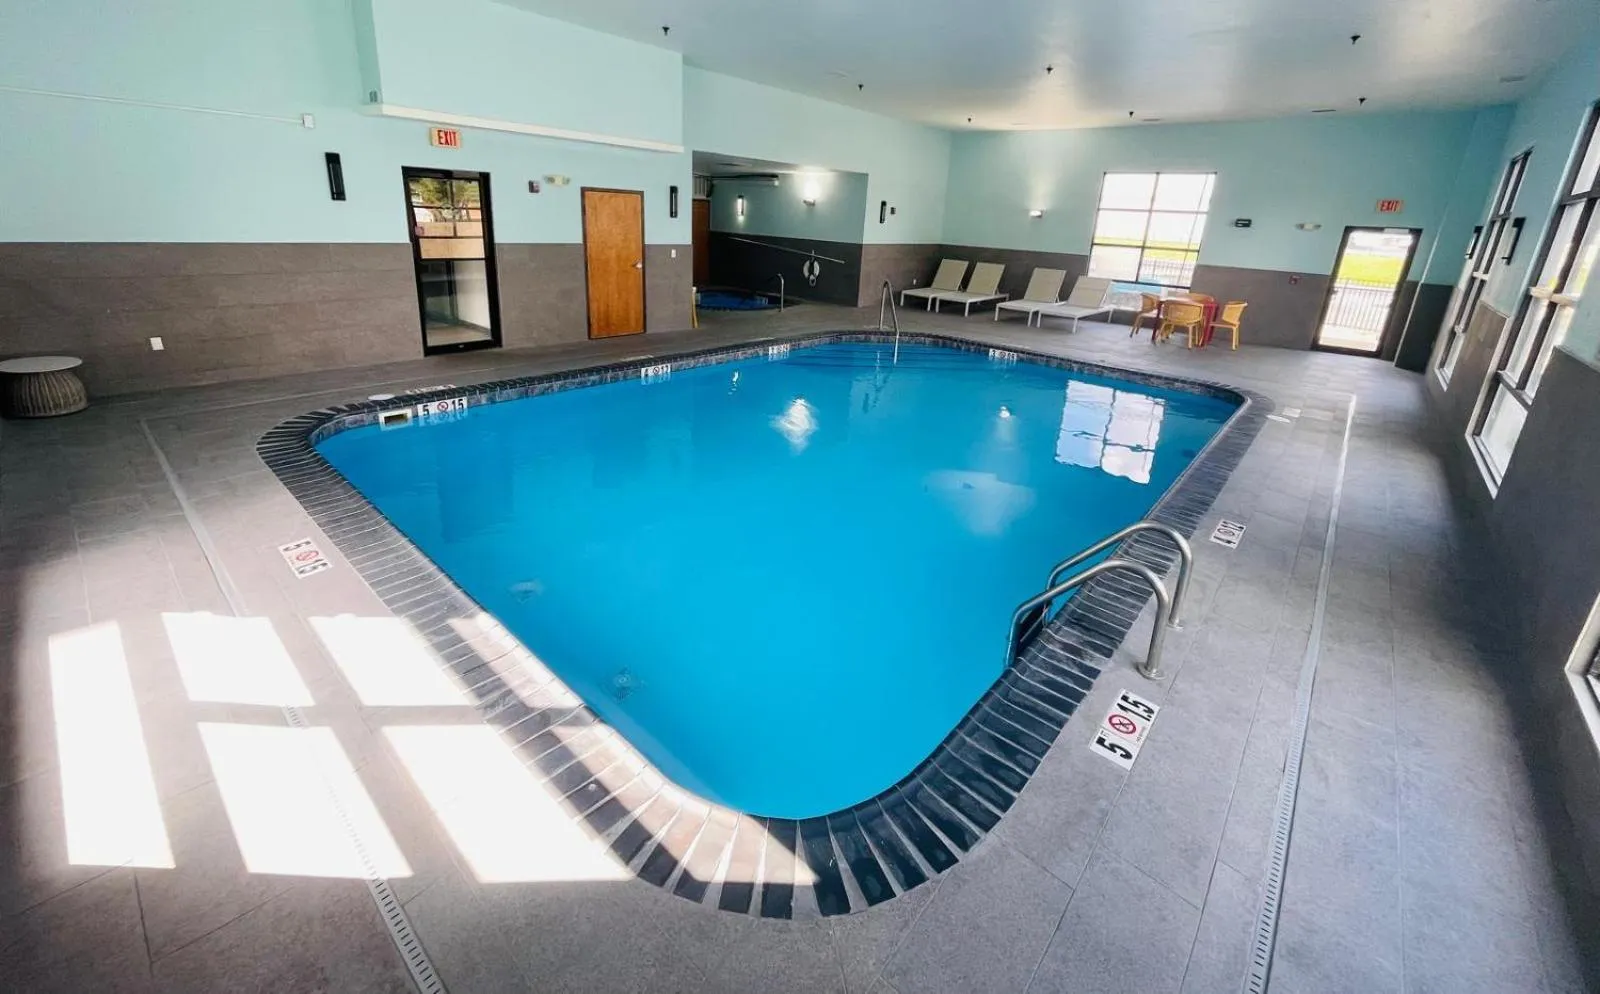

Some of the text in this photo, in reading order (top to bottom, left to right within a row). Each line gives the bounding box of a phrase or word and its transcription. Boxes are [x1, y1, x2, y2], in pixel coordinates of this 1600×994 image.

[437, 129, 457, 146] EXIT
[1380, 200, 1399, 212] EXIT
[423, 404, 430, 416] 5
[282, 541, 311, 551] 5
[1096, 695, 1154, 760] 5 1.5
